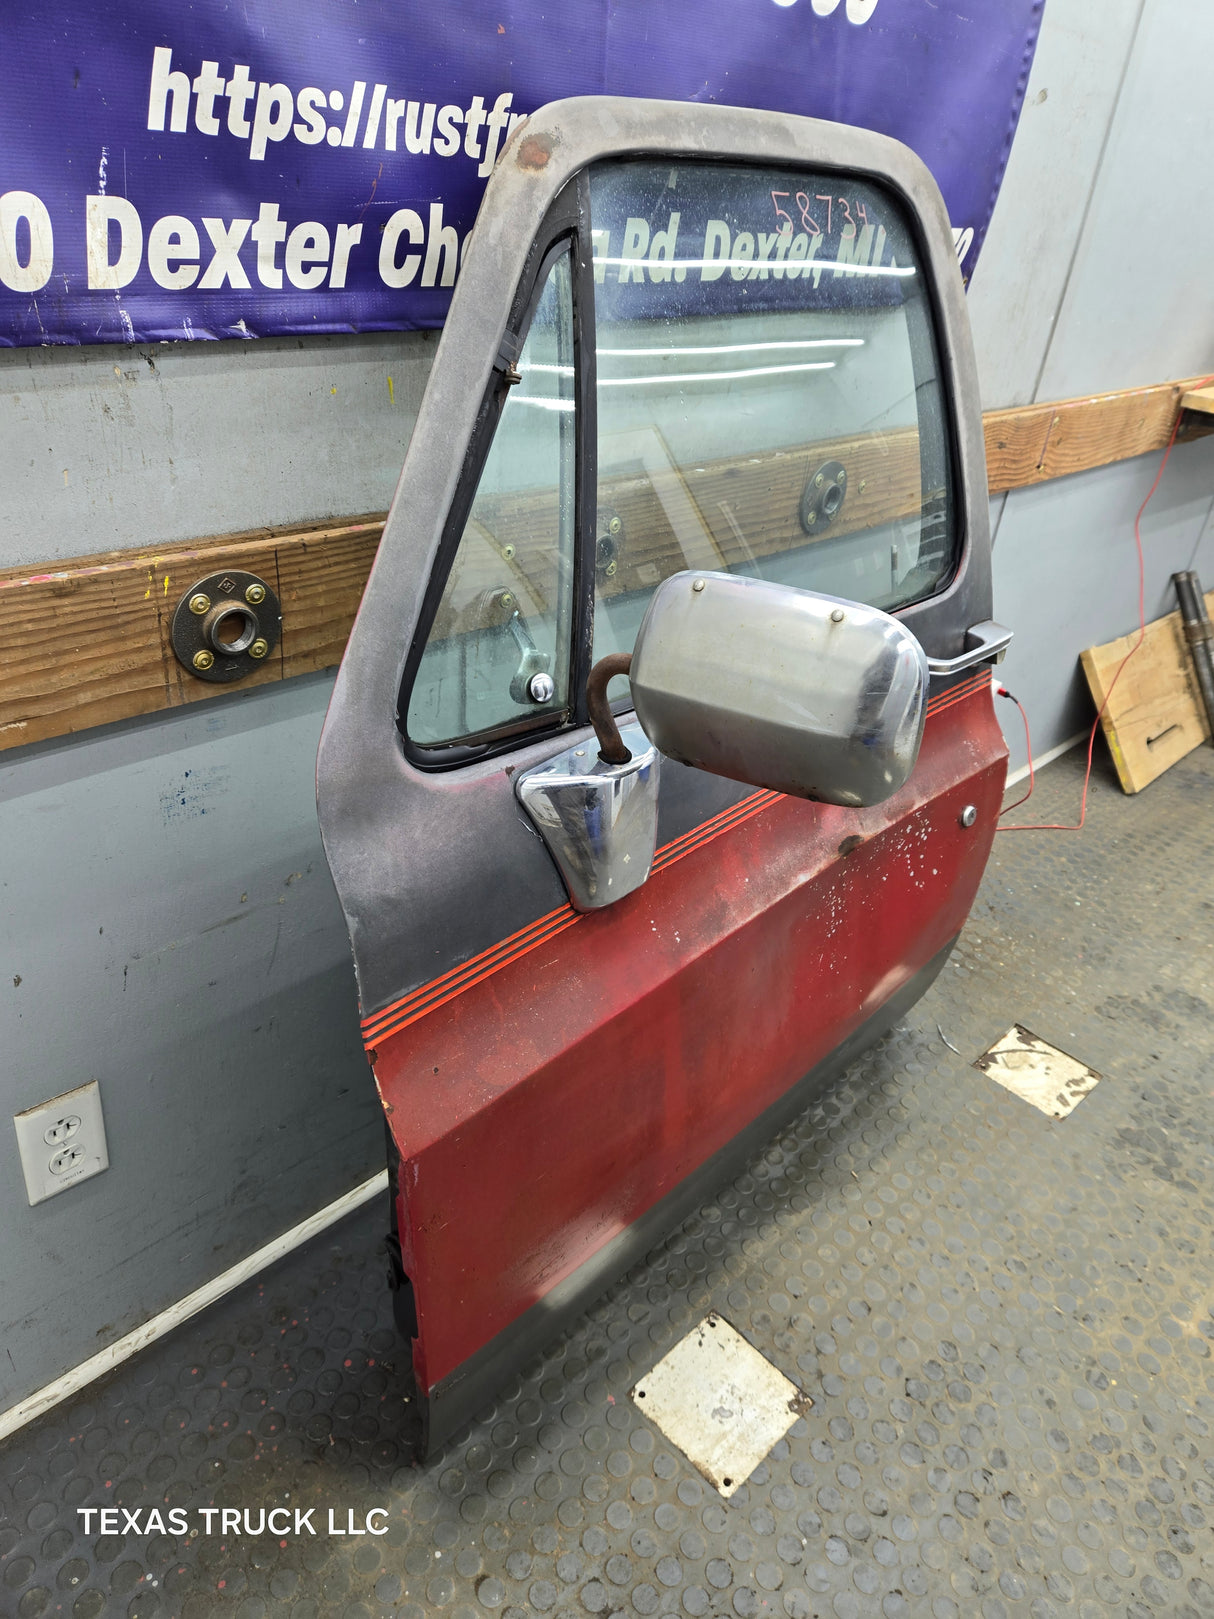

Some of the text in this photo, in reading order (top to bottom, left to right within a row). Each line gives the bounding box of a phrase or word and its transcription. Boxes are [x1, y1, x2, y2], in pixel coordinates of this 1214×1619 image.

[86, 194, 363, 290] Dexter
[378, 202, 474, 289] Ch
[618, 211, 688, 283] Rd.
[700, 219, 824, 289] Dexter,
[771, 190, 870, 240] 58734
